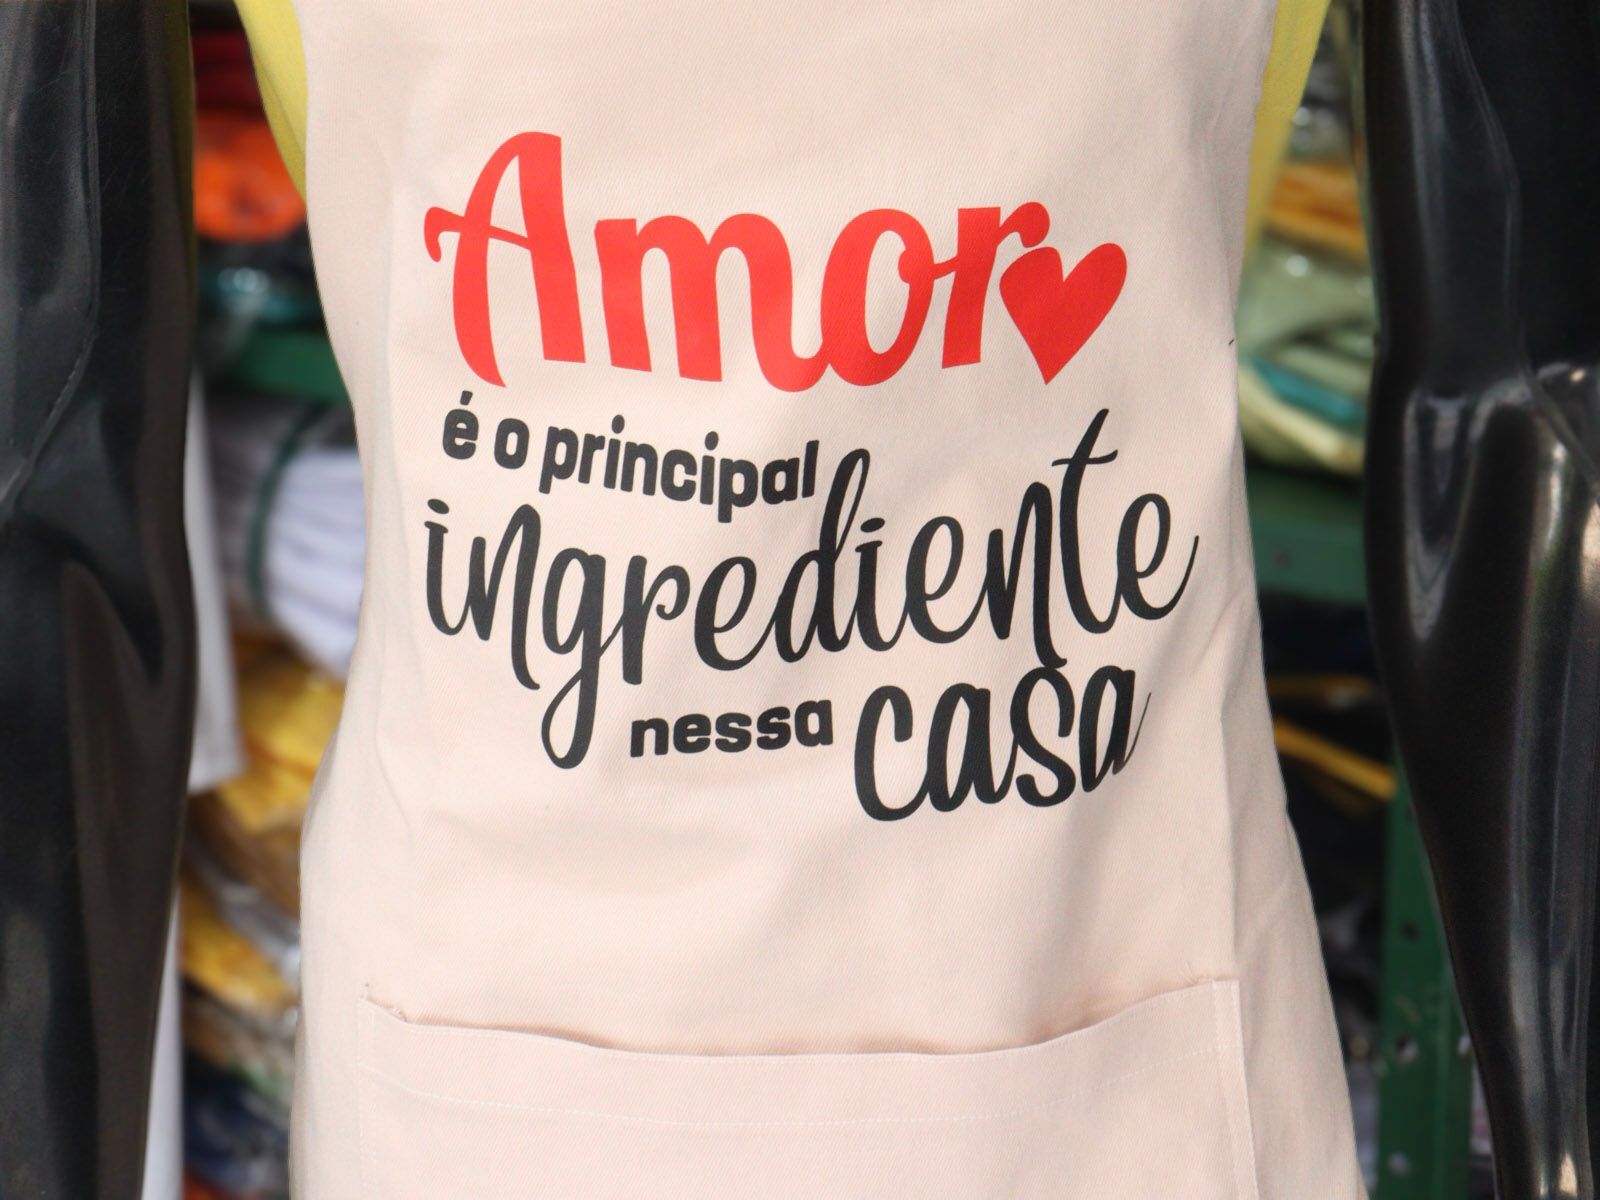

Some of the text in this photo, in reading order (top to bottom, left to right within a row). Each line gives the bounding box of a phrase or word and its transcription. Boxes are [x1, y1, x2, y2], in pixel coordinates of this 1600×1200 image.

[424, 131, 1050, 392] Amor
[442, 390, 820, 524] é o principal
[424, 408, 1200, 769] ingrediente
[630, 665, 1152, 822] nessa casa
